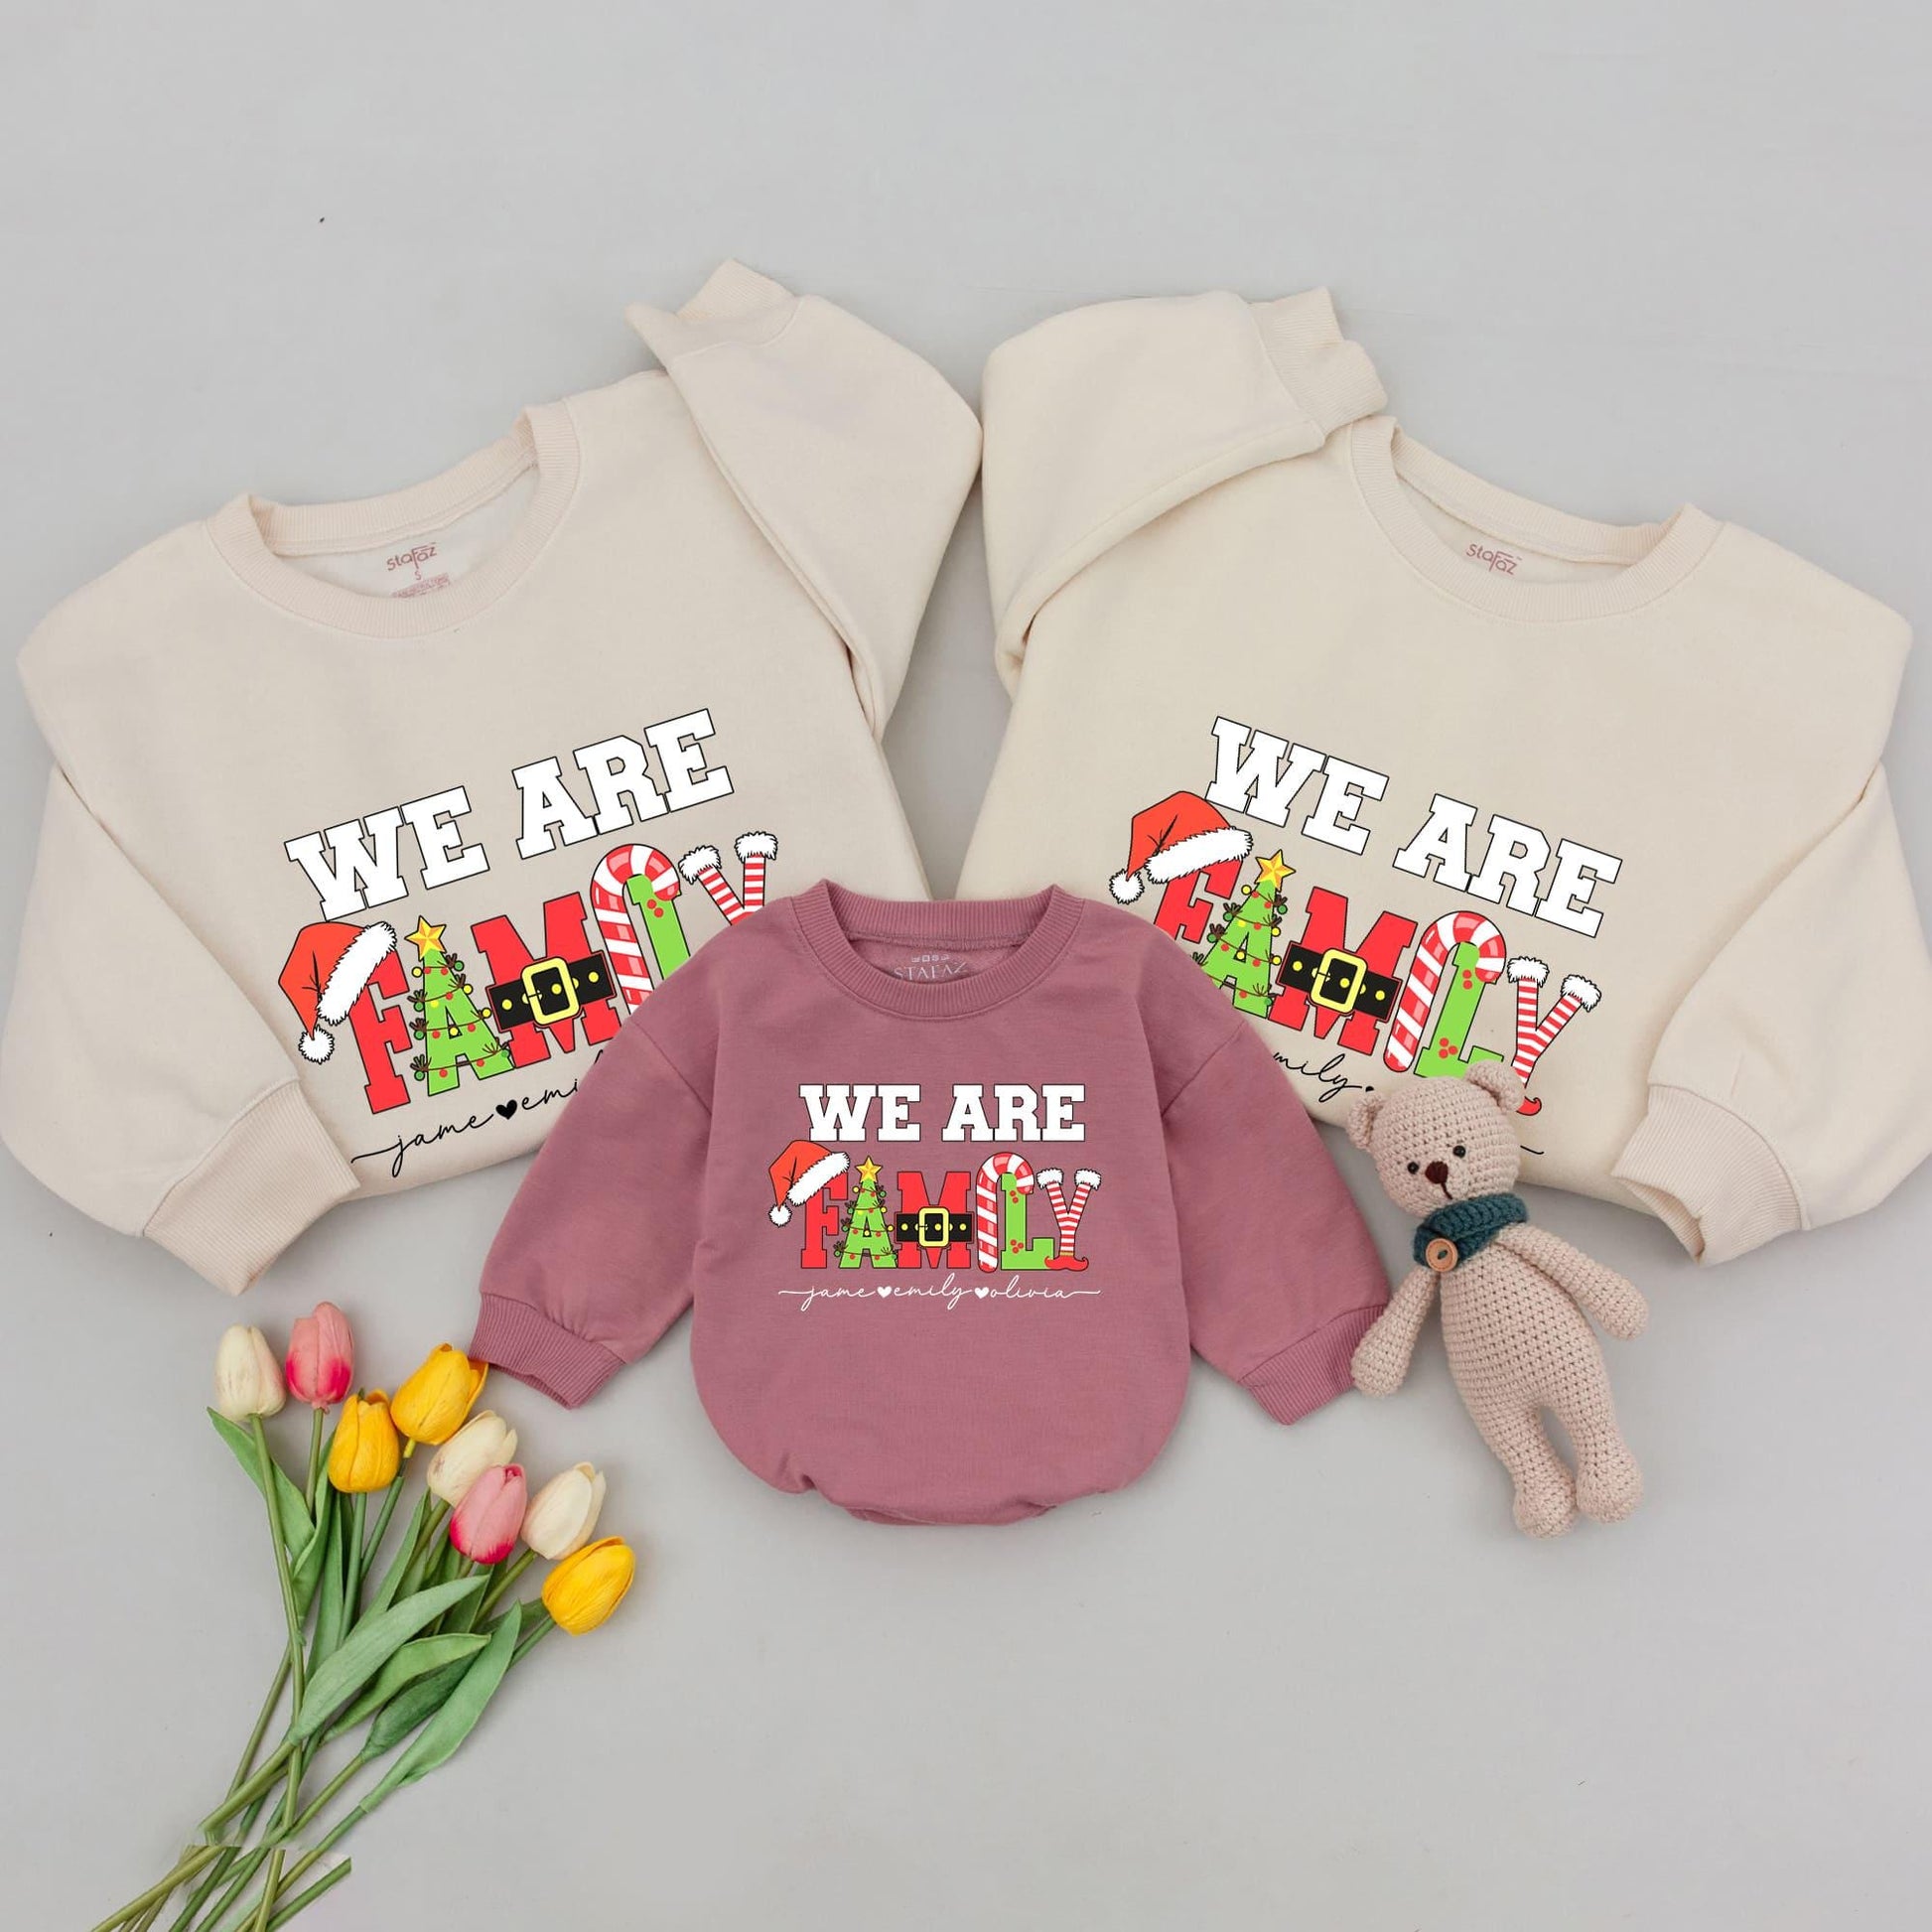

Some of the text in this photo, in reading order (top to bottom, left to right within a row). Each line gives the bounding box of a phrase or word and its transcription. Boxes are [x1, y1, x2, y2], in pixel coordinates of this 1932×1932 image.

[284, 709, 735, 921] WE ARE
[1205, 716, 1623, 939] WE ARE
[1273, 1052, 1362, 1103] mily
[350, 1113, 494, 1178] jame
[799, 1083, 1086, 1143] WE ARE
[800, 1152, 1102, 1273] FAMILY
[778, 1273, 1101, 1311] jame emily olivia
